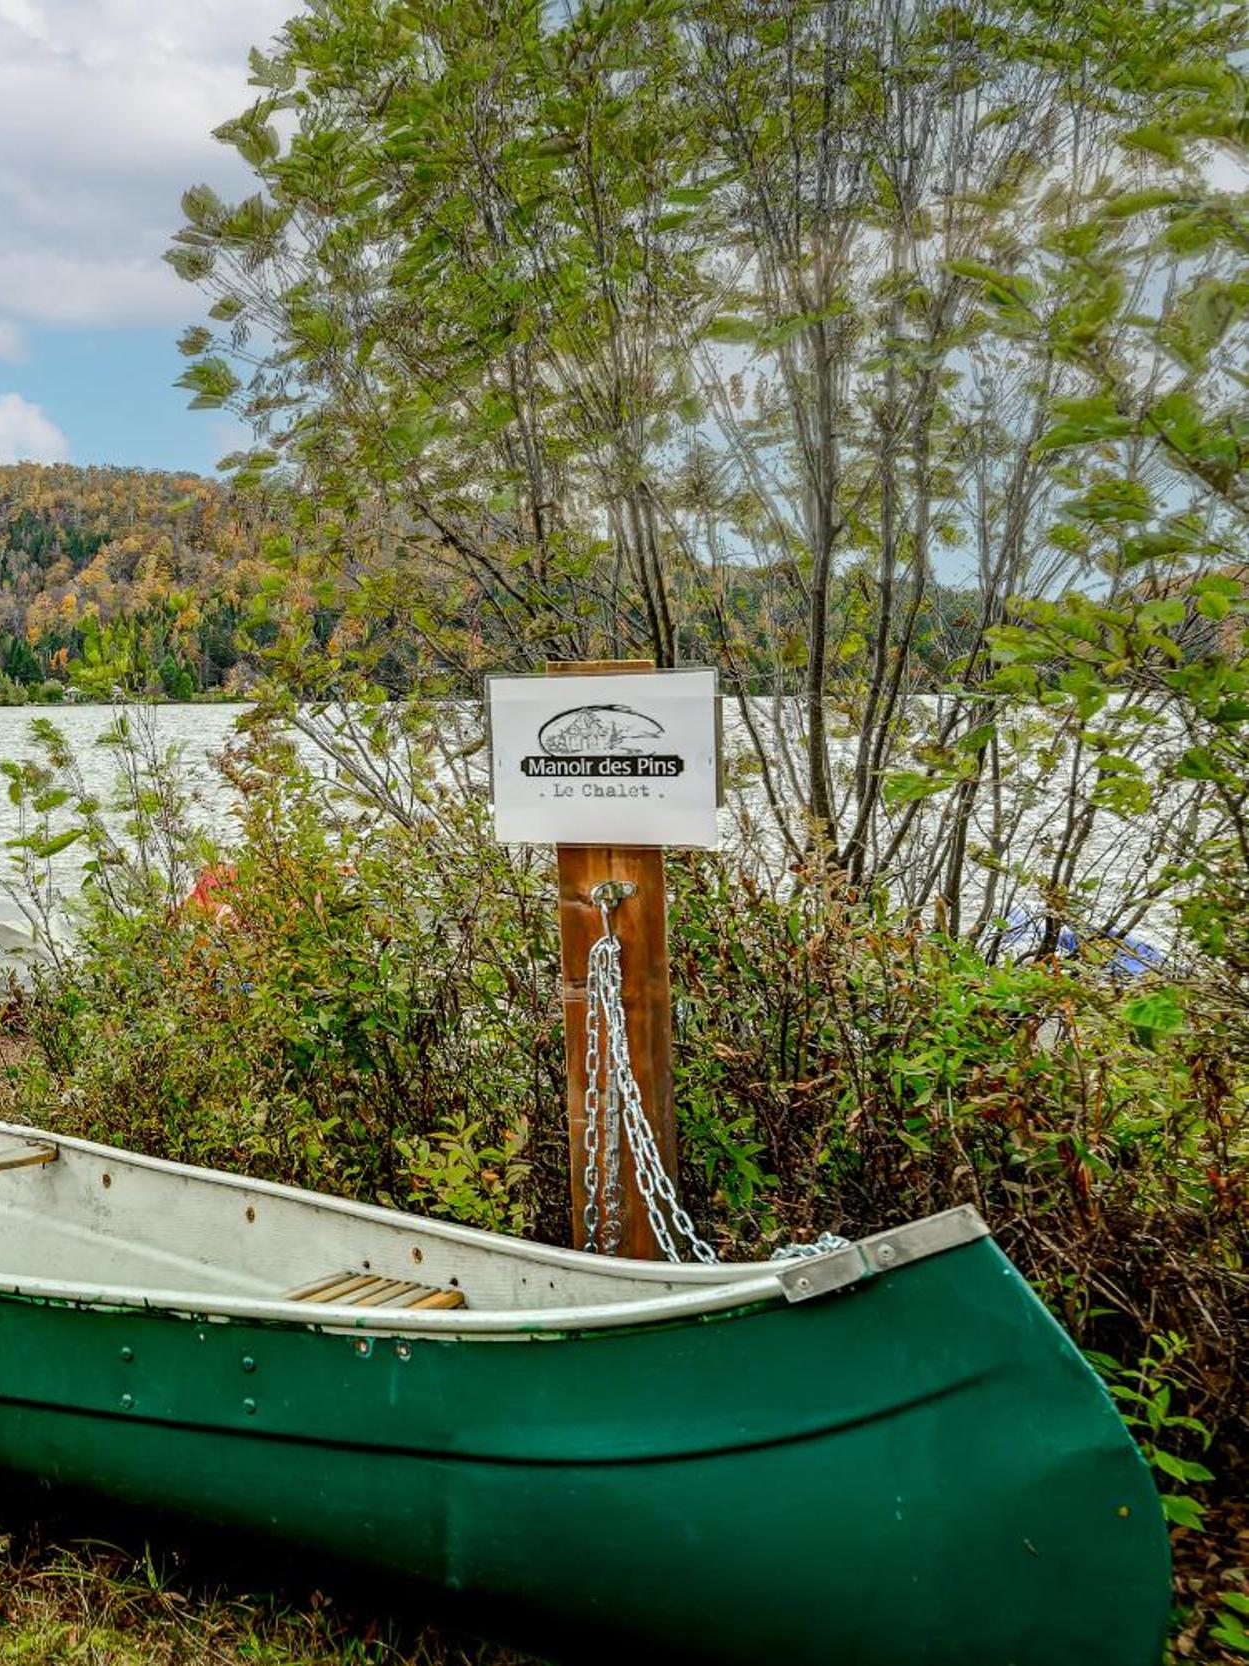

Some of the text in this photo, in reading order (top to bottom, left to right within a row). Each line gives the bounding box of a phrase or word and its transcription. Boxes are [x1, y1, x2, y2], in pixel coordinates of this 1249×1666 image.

[528, 757, 677, 775] Manoir des Pins
[553, 783, 650, 798] Le Chalet
